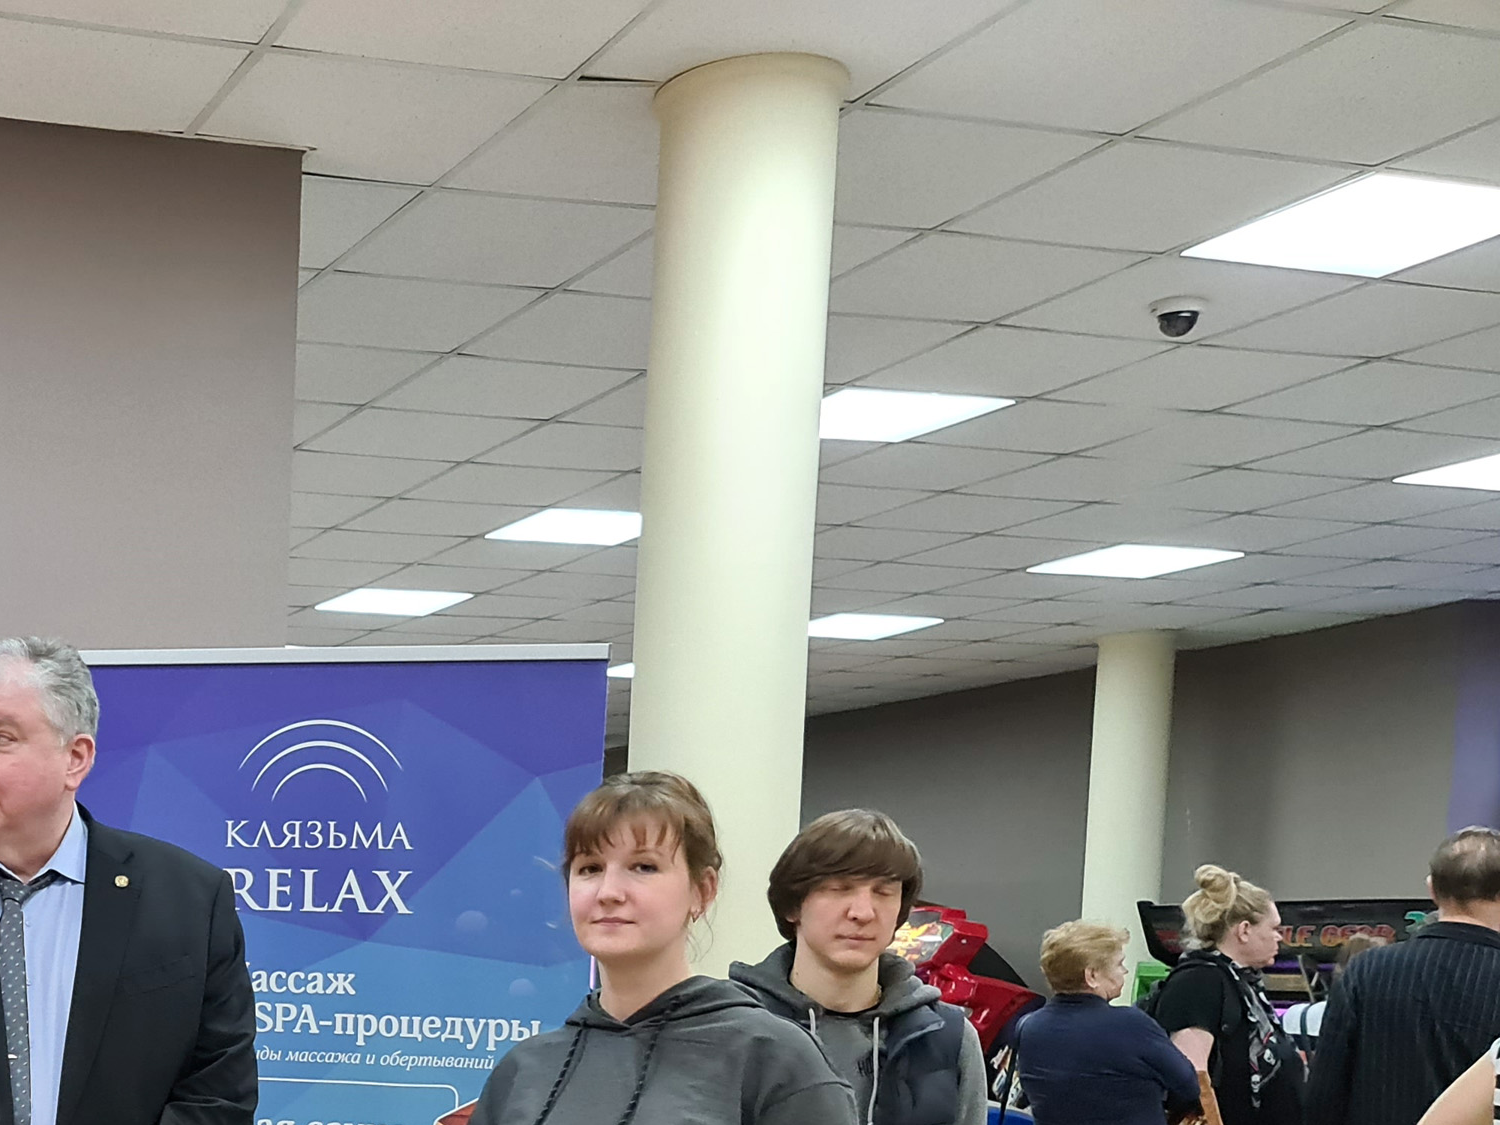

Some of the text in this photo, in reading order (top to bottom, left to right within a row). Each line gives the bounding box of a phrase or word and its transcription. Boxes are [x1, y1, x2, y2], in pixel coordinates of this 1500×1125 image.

[225, 819, 414, 850] КЛЯЗЬМА
[223, 867, 414, 914] RELAX
[246, 961, 357, 995] ассаж
[255, 1001, 541, 1051] SPA-процедуры
[285, 1050, 361, 1065] массажа
[365, 1053, 376, 1065] и
[379, 1050, 495, 1071] обертываний
